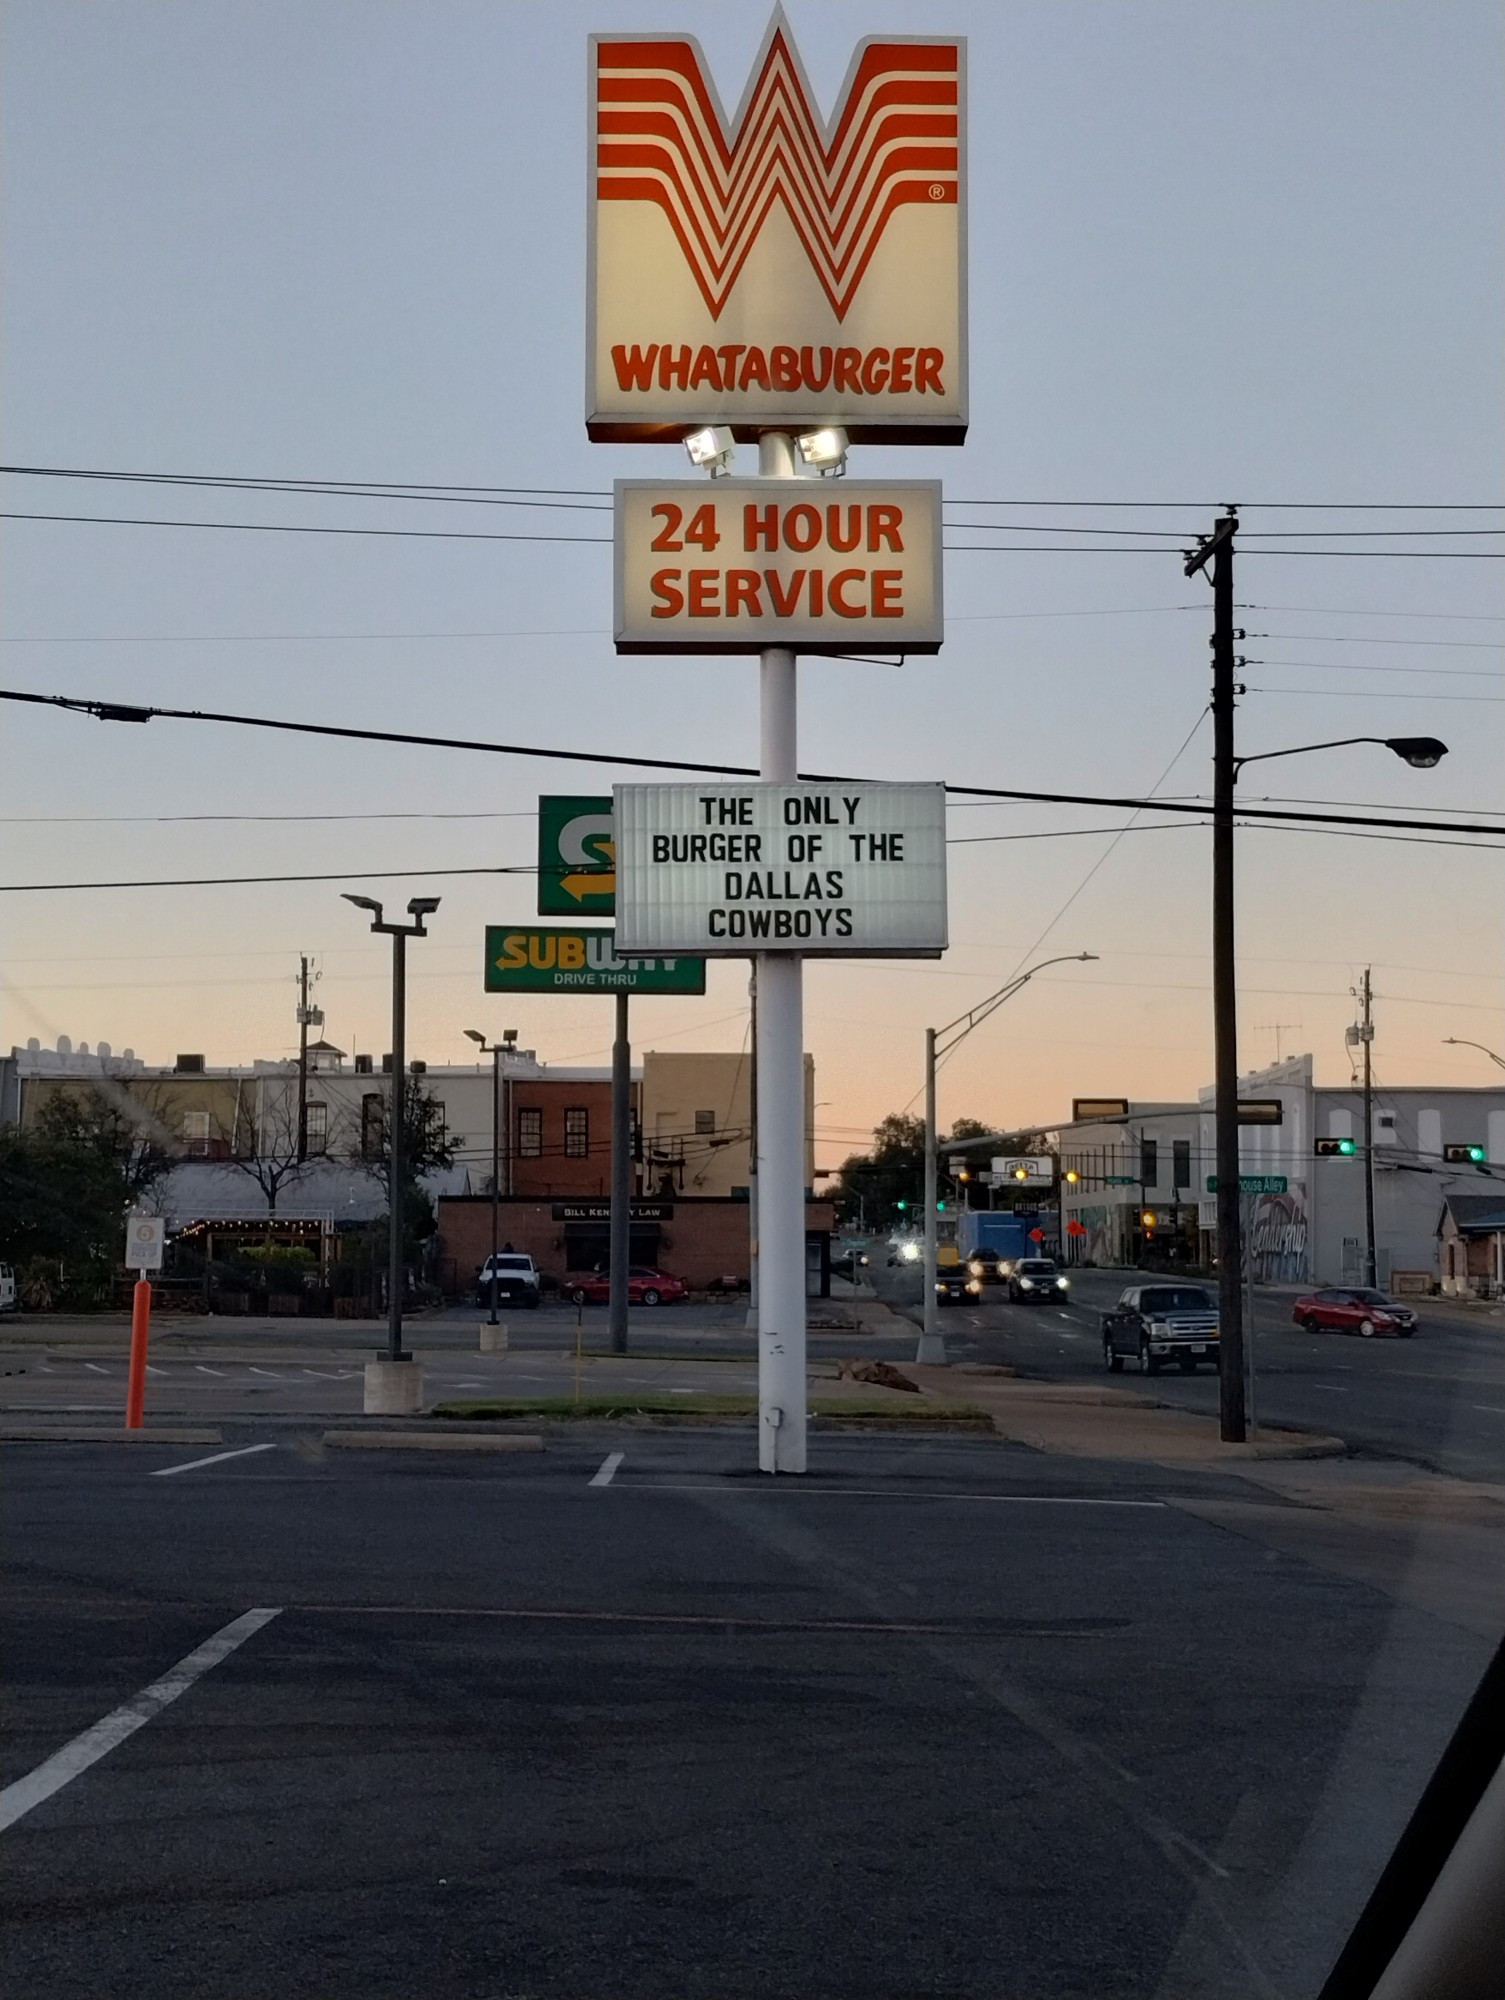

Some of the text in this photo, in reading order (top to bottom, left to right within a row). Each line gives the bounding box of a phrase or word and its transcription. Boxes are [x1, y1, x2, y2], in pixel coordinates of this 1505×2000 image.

[611, 343, 945, 396] WHATABURGER
[650, 503, 905, 553] 24 HOUR
[650, 568, 905, 619] SERVICE
[699, 796, 861, 826] THE ONLY
[653, 833, 904, 863] BURGER OF THE
[725, 870, 843, 900] DALLAS
[708, 908, 853, 938] COWBOYS
[554, 973, 638, 985] DRIVE THRU
[1263, 1176, 1284, 1193] Alley
[564, 1208, 586, 1217] BILL
[638, 1208, 661, 1217] LAW
